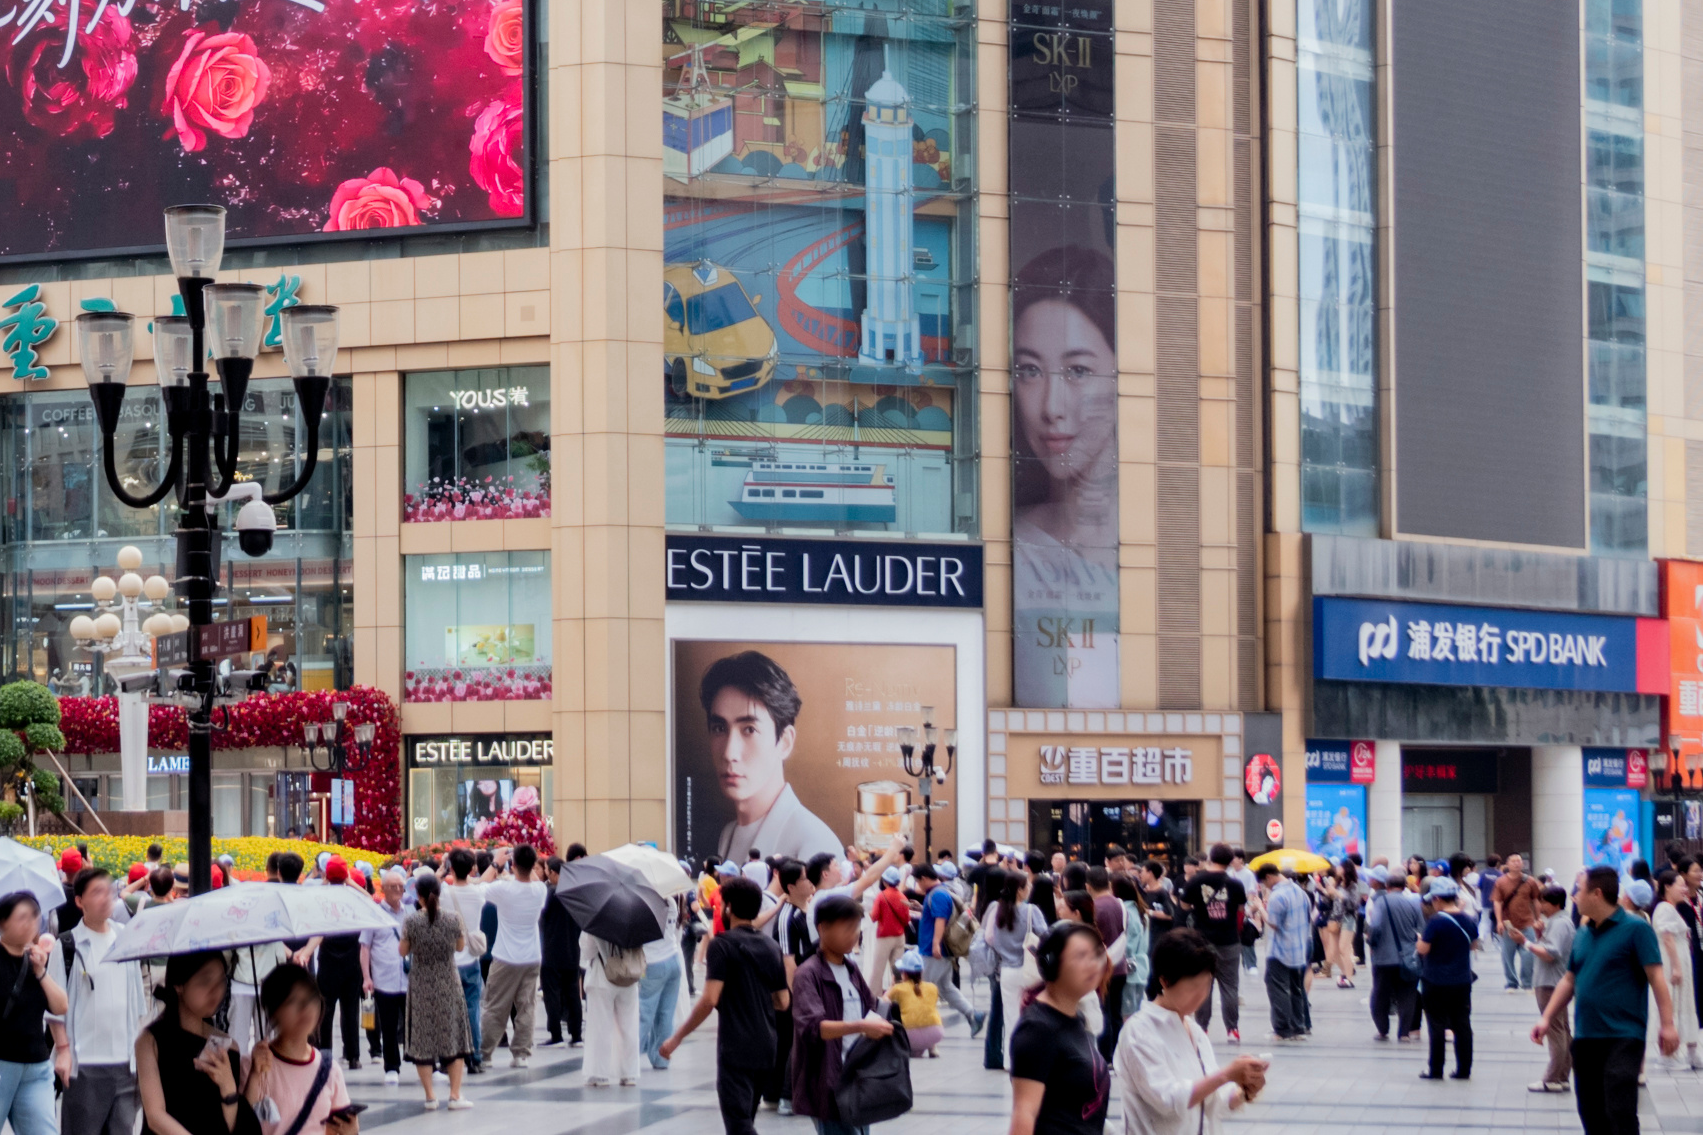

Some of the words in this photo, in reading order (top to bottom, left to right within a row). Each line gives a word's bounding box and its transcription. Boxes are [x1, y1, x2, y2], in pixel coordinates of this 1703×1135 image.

[1033, 32, 1092, 68] SK-II
[42, 408, 93, 422] COFFEE
[450, 389, 506, 409] YOUS
[803, 553, 965, 596] LAUDER
[1406, 620, 1502, 663] 浦发银行
[1505, 630, 1547, 663] SPD
[1549, 633, 1607, 667] BANK
[1068, 746, 1193, 784] 重百超市
